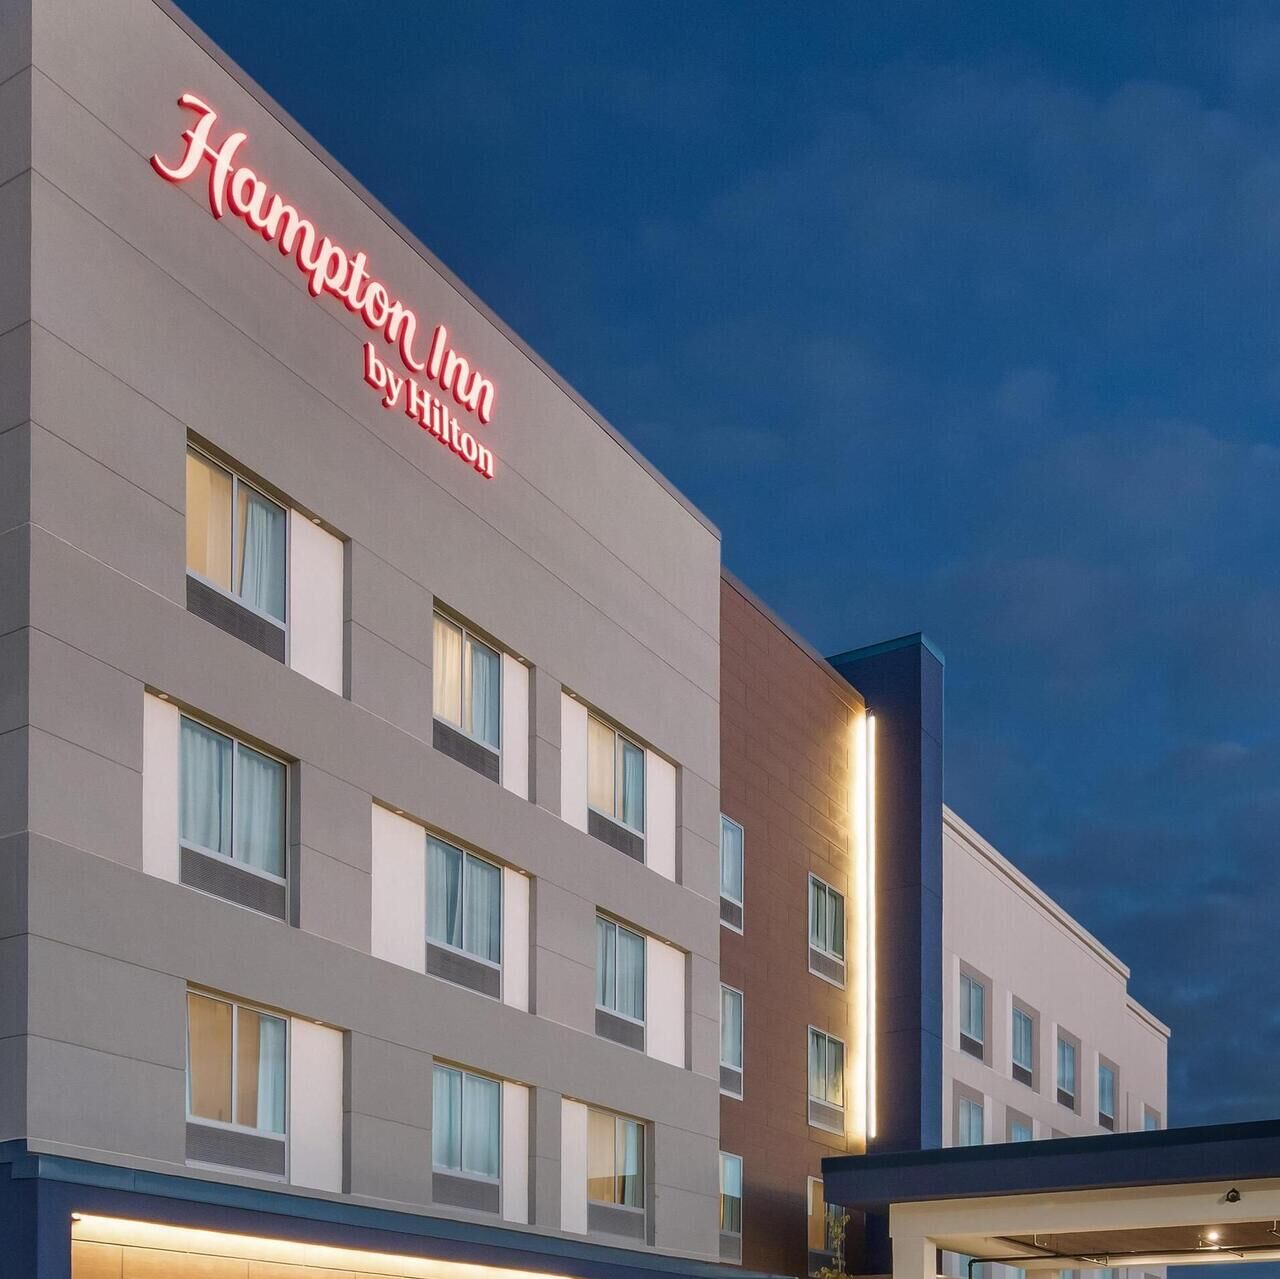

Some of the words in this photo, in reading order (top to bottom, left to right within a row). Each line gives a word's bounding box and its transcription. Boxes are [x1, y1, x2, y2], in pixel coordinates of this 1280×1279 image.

[149, 93, 425, 373] Hampton
[426, 325, 495, 423] Inn
[363, 341, 406, 408] by
[405, 378, 494, 479] Hilton
